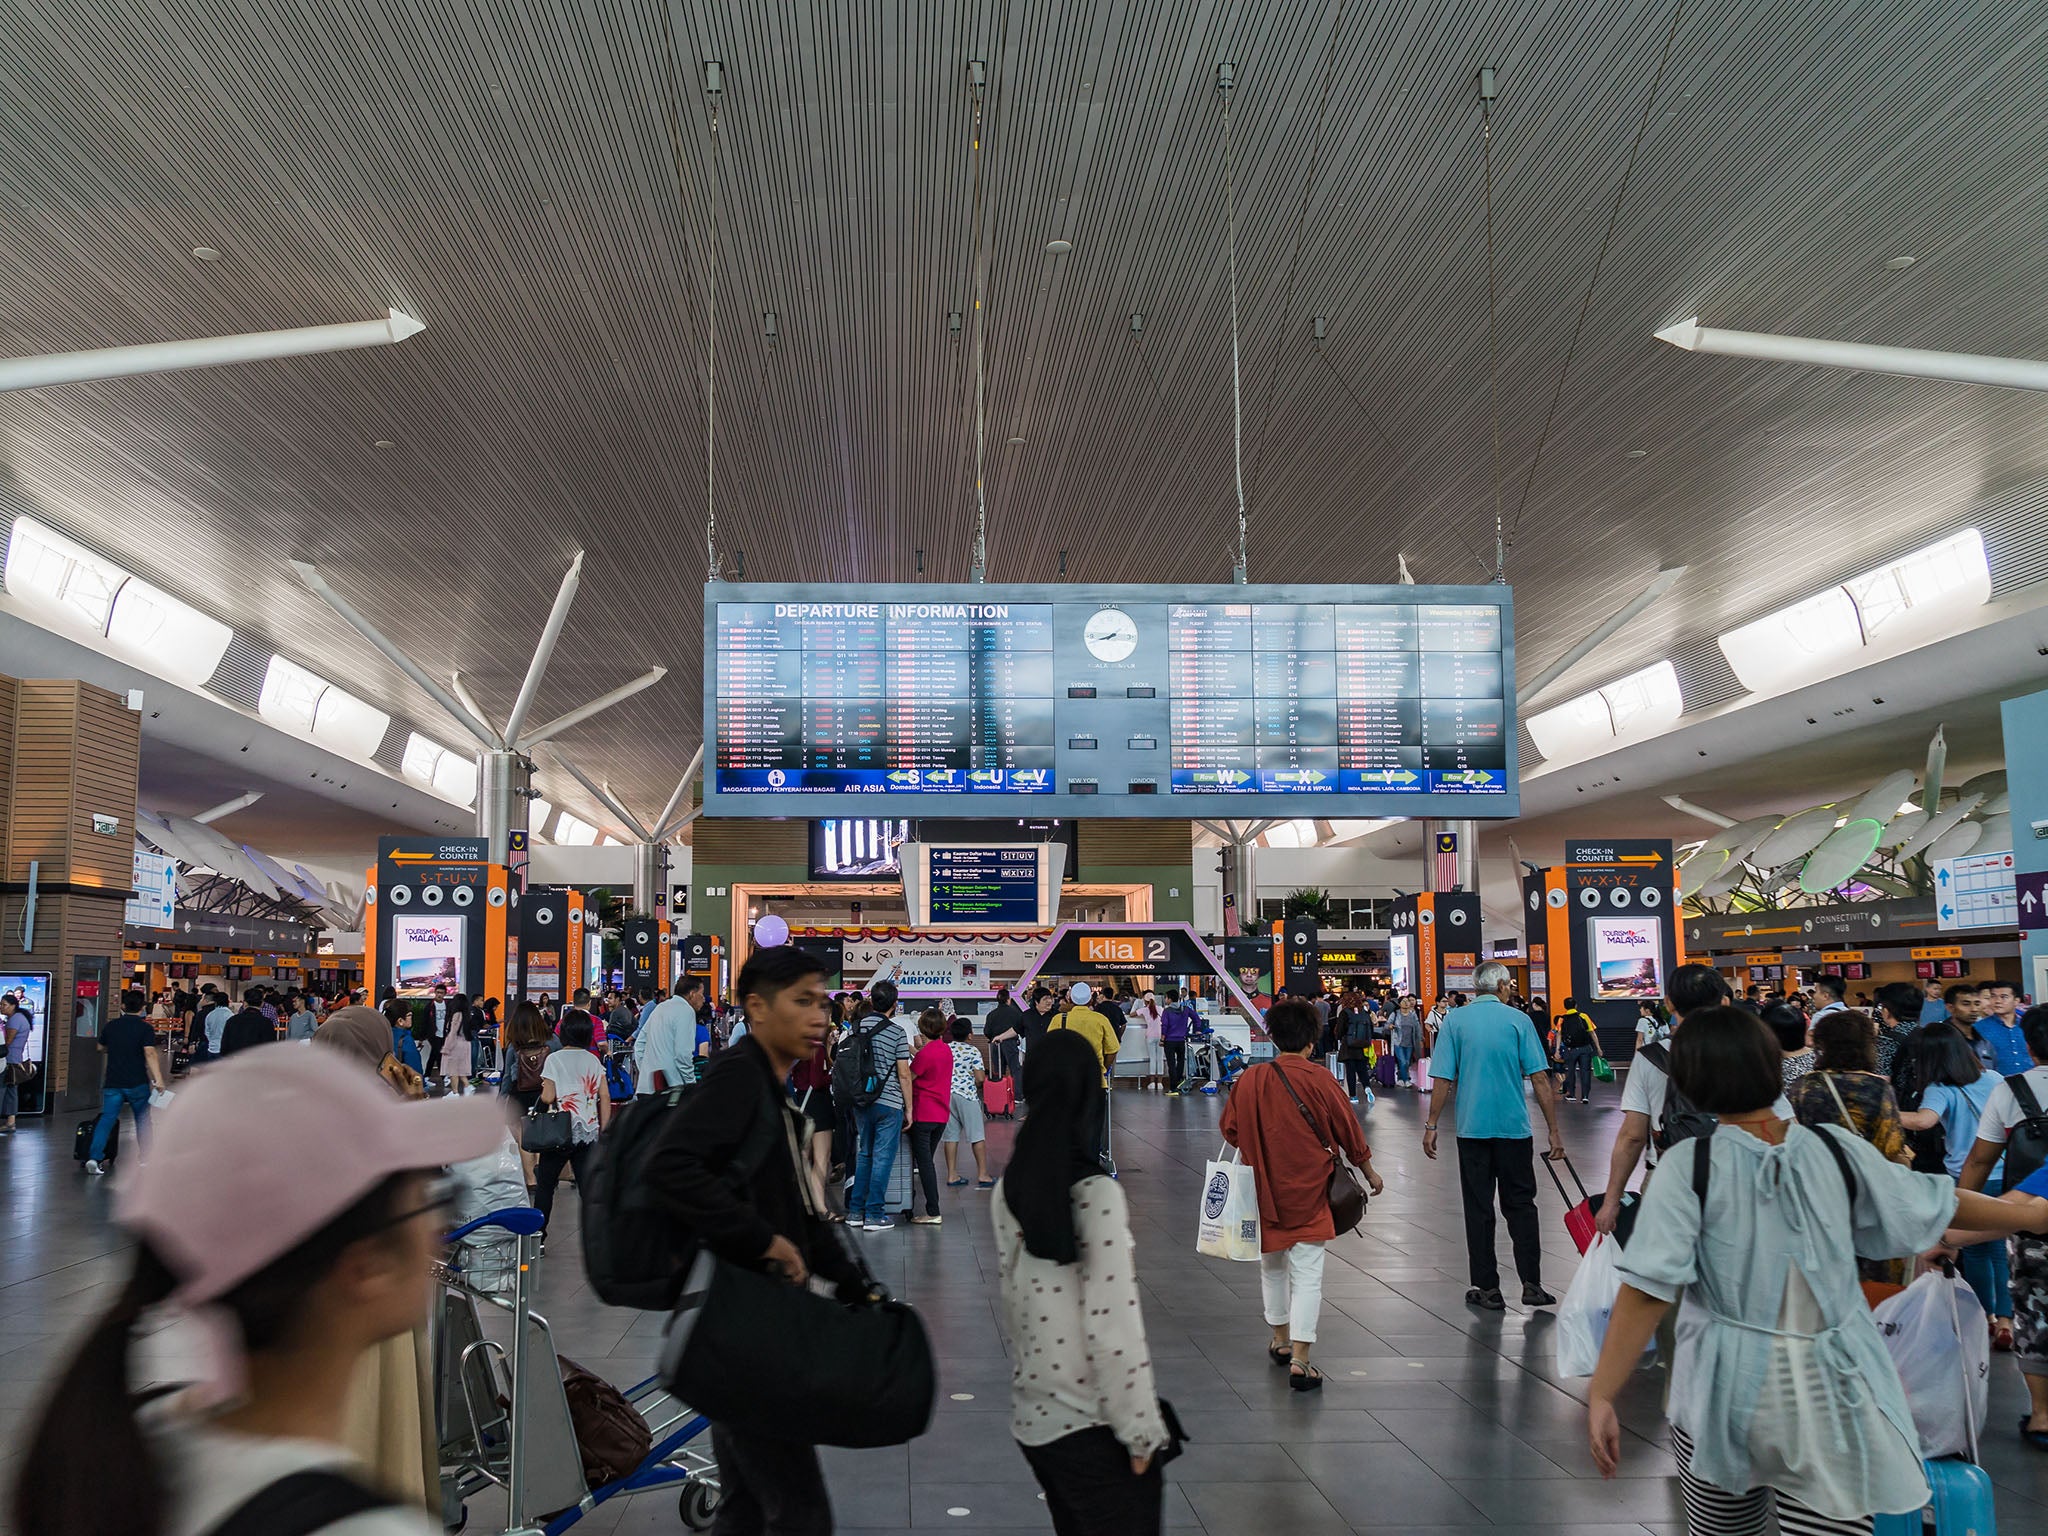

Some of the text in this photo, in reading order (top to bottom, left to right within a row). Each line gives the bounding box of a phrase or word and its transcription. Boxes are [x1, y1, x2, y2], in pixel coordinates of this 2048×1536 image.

[775, 604, 1009, 618] DEPARTURE INFORMATION
[907, 769, 920, 784] S
[944, 769, 956, 783] T
[990, 769, 1003, 784] U
[1033, 769, 1046, 784] V
[1216, 769, 1235, 784] W
[1298, 769, 1311, 784] X
[1382, 769, 1395, 784] Y
[1463, 769, 1476, 784] Z
[439, 845, 478, 853] CHECK-IN
[1815, 913, 1869, 924] CONNECTIVITY
[1834, 924, 1850, 933] HUB
[409, 935, 449, 946] MALAYSIA
[1607, 936, 1647, 947] MALAYSIA
[900, 949, 1004, 958] Perlepasan Antbangsa
[1089, 940, 1166, 959] klia 2
[845, 952, 854, 963] Q
[1322, 953, 1356, 962] SAFARI
[1423, 942, 1431, 975] CHECK-IN
[899, 976, 952, 985] AIRPORTS
